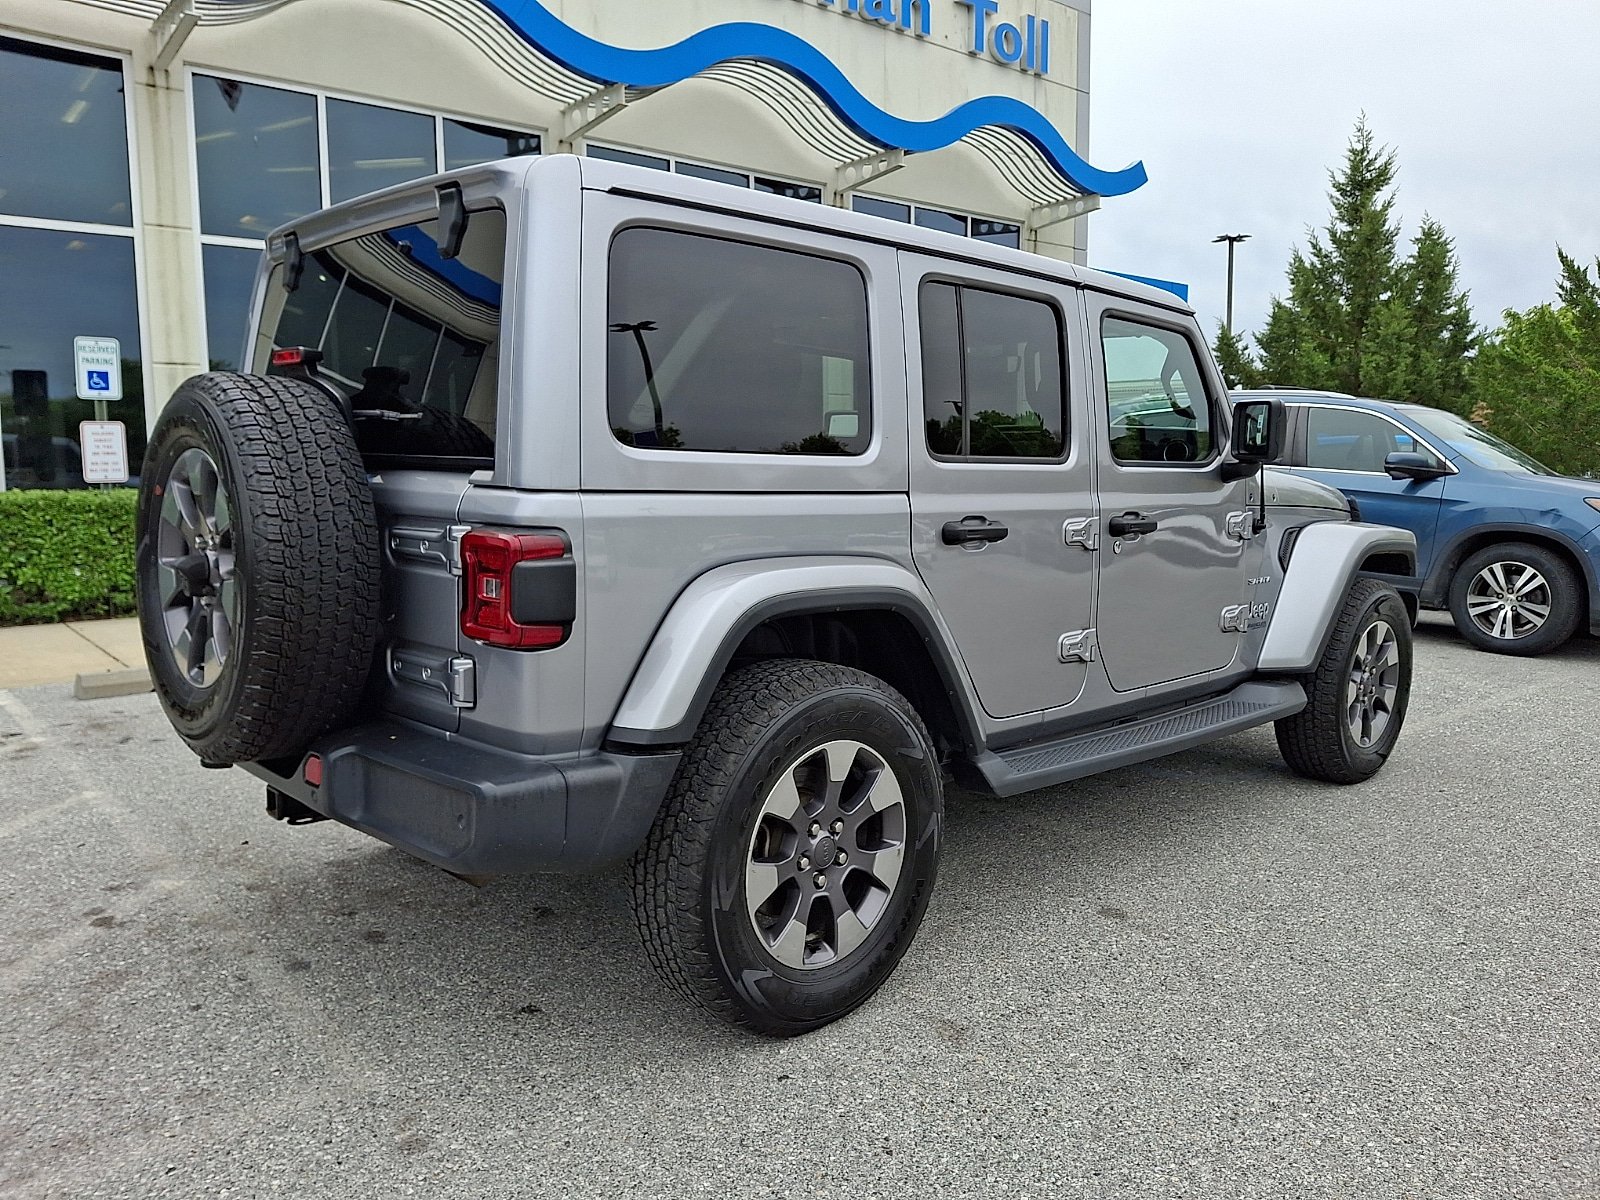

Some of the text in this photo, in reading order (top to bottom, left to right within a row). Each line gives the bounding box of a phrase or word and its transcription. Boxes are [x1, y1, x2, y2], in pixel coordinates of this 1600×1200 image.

[955, 0, 1050, 75] Toll
[77, 345, 115, 353] RESERVED
[81, 357, 113, 366] PARKING
[1248, 600, 1269, 619] Jeep
